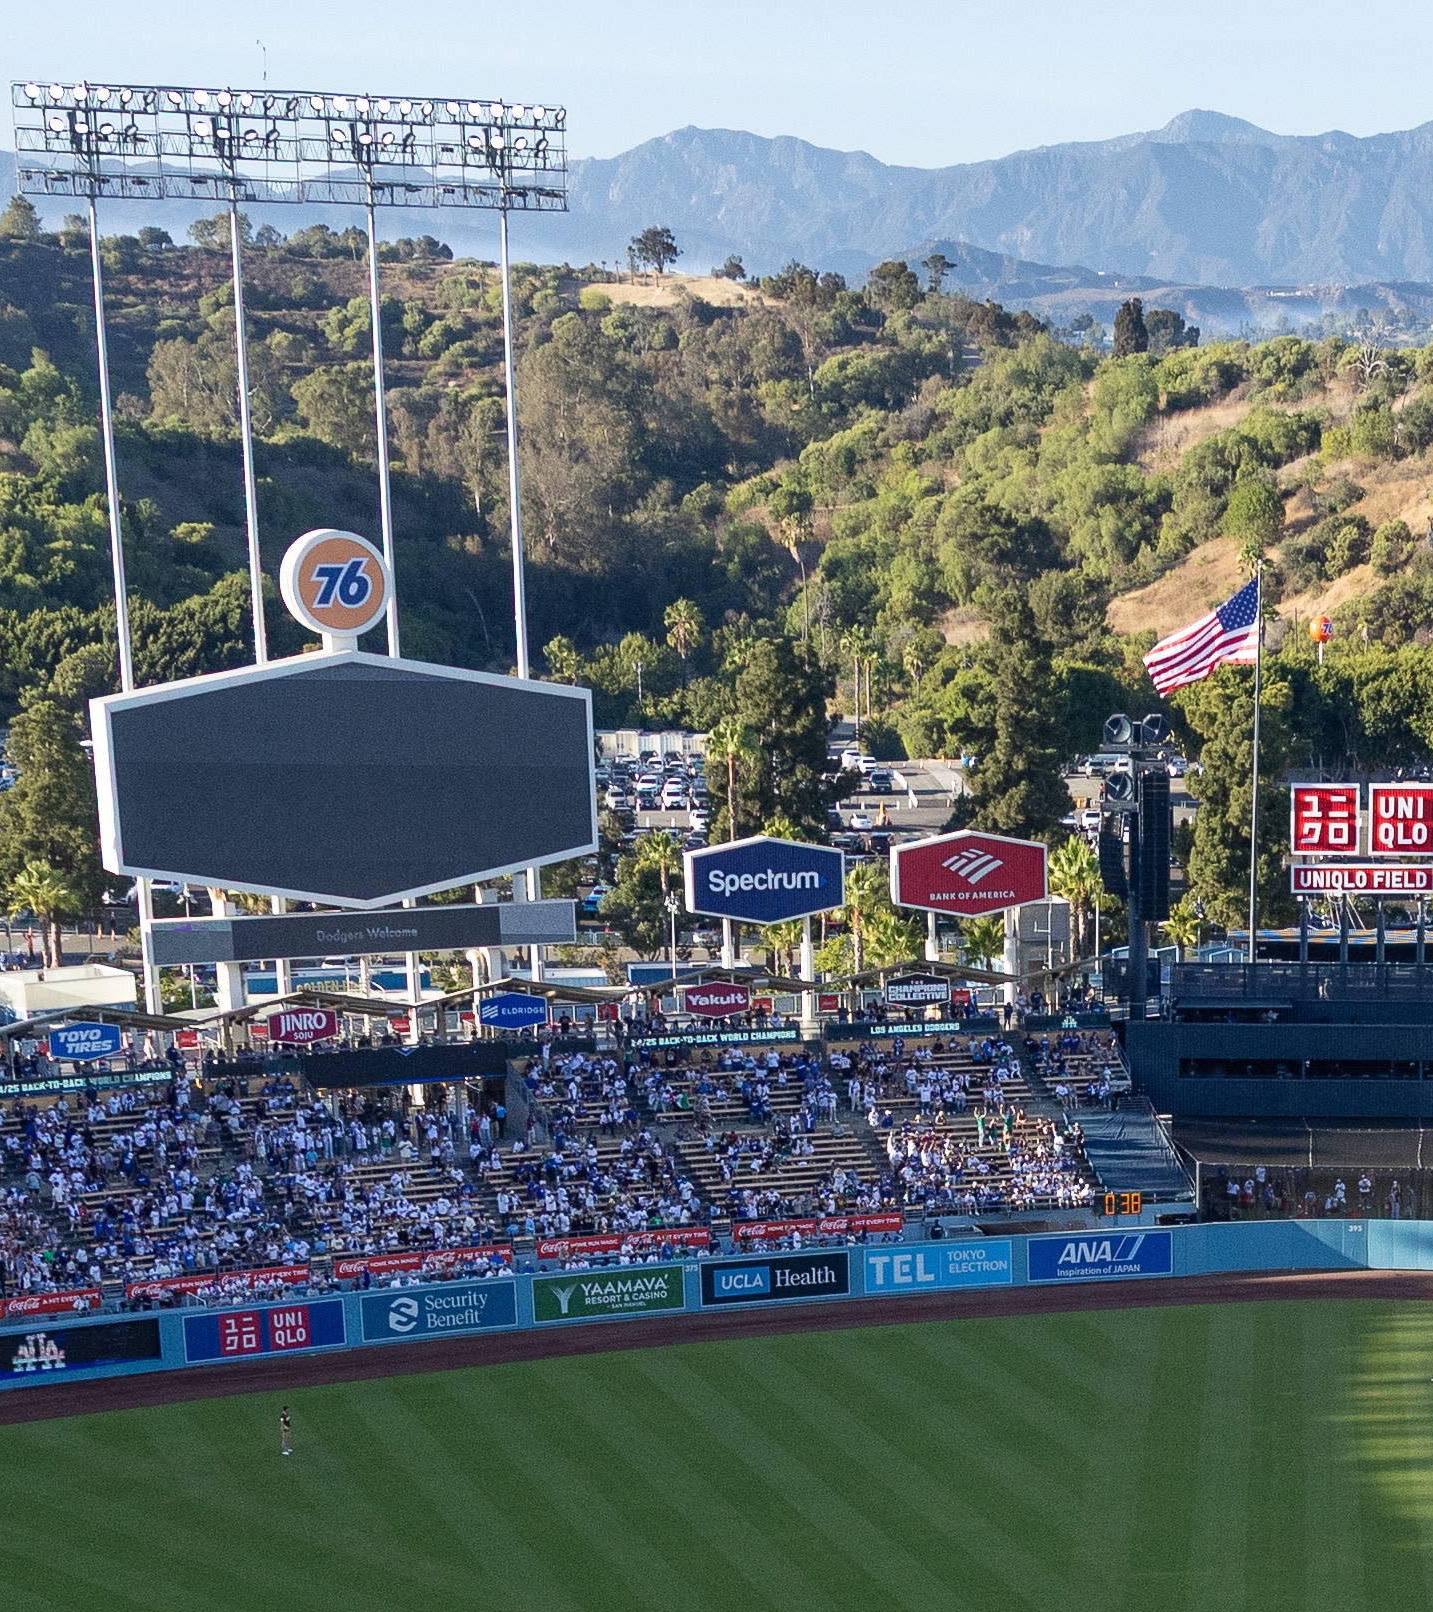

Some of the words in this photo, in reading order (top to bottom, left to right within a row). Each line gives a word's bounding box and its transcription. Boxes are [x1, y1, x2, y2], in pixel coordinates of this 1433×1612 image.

[310, 556, 372, 608] 76
[1302, 796, 1348, 818] ユニ
[1379, 796, 1424, 819] UNI
[1301, 823, 1349, 844] クロ
[1378, 823, 1427, 848] QLO
[709, 869, 819, 897] Spectrum
[1300, 870, 1367, 889] UNIQLO
[1373, 871, 1427, 889] FIELD
[929, 892, 957, 901] BANK
[958, 892, 971, 900] OF
[971, 890, 1016, 900] AMERICA
[316, 929, 364, 945] Dodgers
[366, 925, 418, 941] Welcome
[888, 983, 948, 995] CHAMPIONS
[889, 991, 949, 1002] COLLECTIVE
[688, 992, 749, 1007] Yakult
[501, 1005, 544, 1017] ELDRIDGE
[280, 1012, 327, 1038] JINRO
[57, 1029, 104, 1042] TOYO
[67, 1040, 113, 1054] TIRES
[21, 1078, 87, 1093] BACK-TO-BACK
[121, 1070, 173, 1084] CHAMPIONS
[947, 1250, 986, 1262] TOKYO
[1057, 1240, 1114, 1264] ANA
[685, 1264, 699, 1273] 375
[775, 1266, 836, 1287] Health
[869, 1253, 935, 1285] TEL
[948, 1261, 1007, 1274] ELECTRON
[1057, 1266, 1101, 1277] Inspiration
[1103, 1265, 1112, 1274] of
[1113, 1263, 1141, 1274] JAPAN
[721, 1273, 763, 1291] UCLA
[425, 1292, 488, 1311] Security
[585, 1294, 622, 1305] RESORT
[623, 1294, 631, 1302] &
[632, 1290, 668, 1301] CASINO
[225, 1316, 256, 1333] ユニ
[273, 1312, 303, 1329] UNI
[427, 1310, 481, 1329] Benefit
[225, 1333, 256, 1351] クロ
[275, 1328, 306, 1347] QLO
